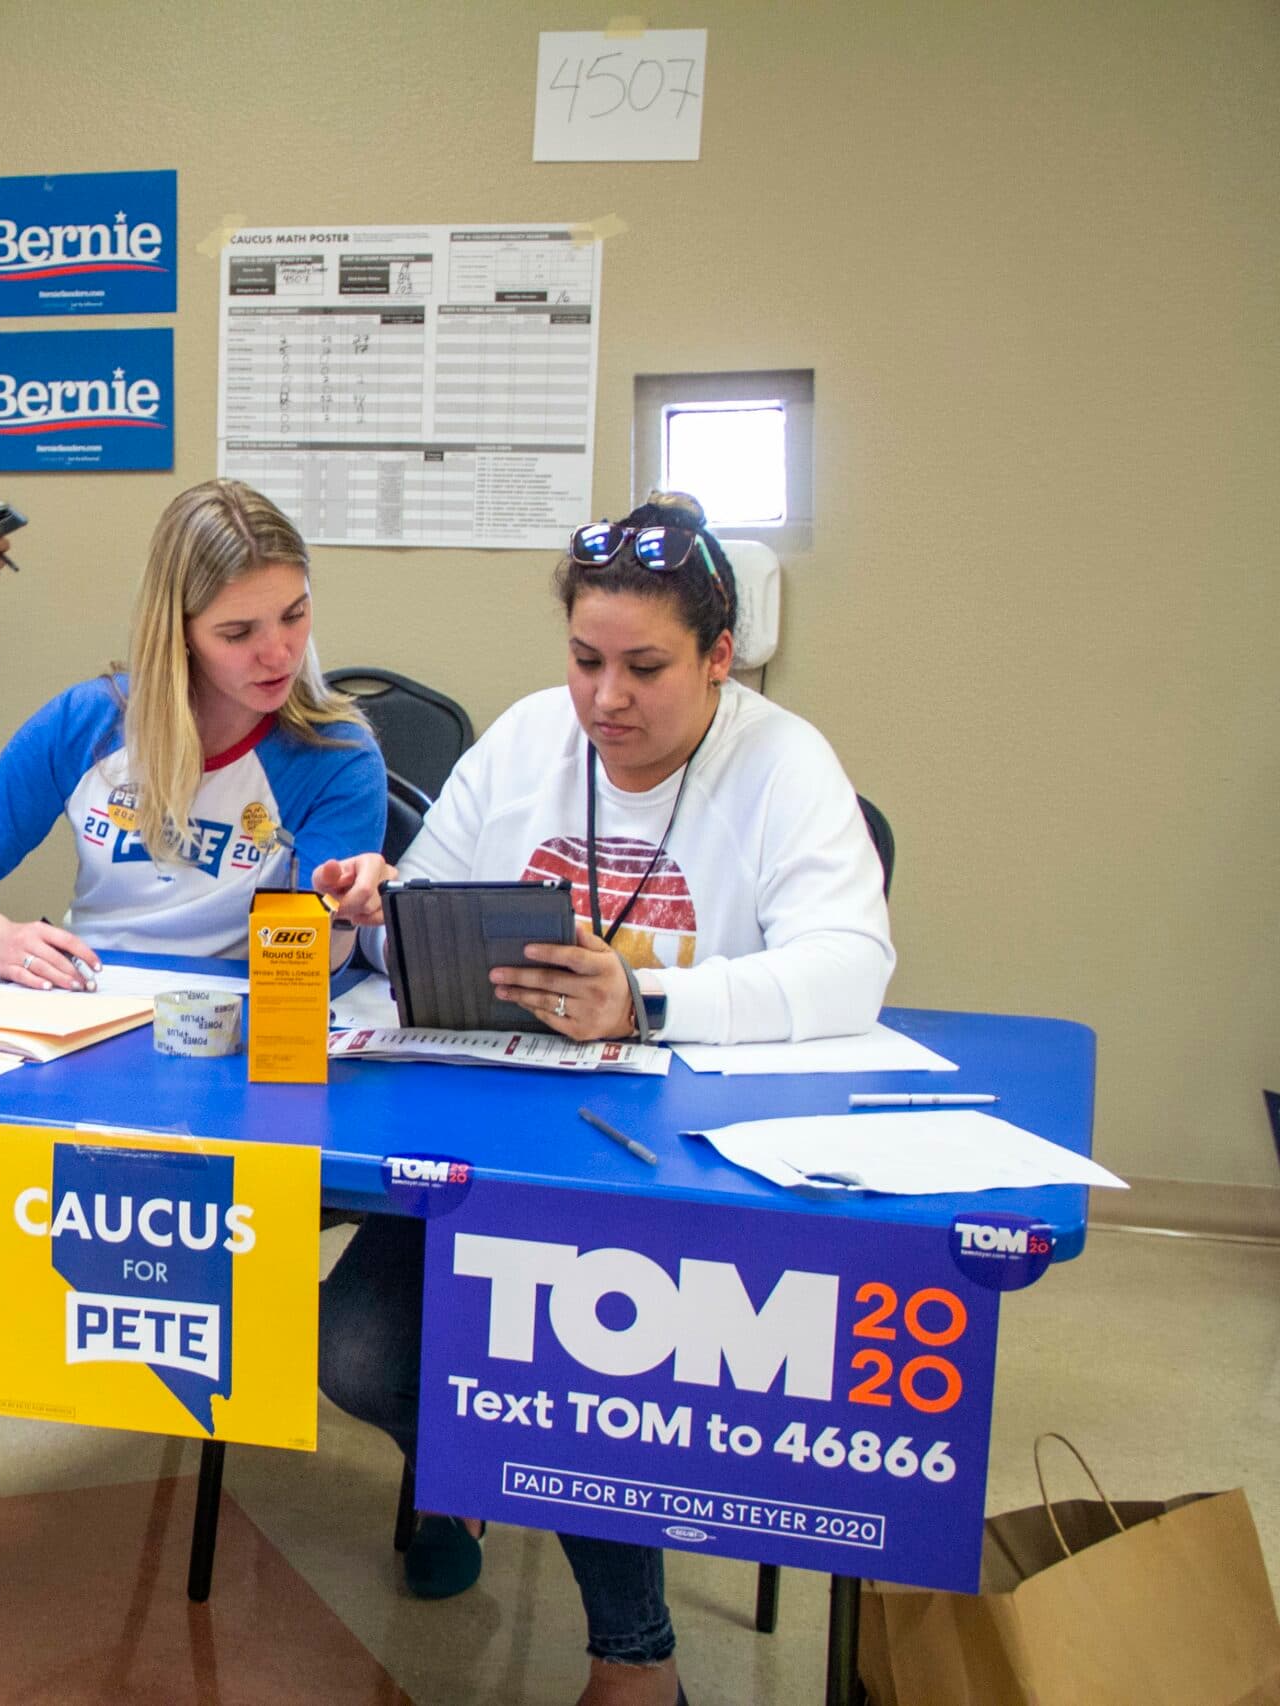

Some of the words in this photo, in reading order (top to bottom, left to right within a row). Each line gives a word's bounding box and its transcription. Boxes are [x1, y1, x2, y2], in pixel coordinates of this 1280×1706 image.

[549, 51, 700, 123] 4507
[230, 233, 273, 245] CAUCUS
[276, 232, 307, 244] MATH
[309, 231, 350, 243] POSTER
[83, 815, 110, 839] 20
[231, 842, 261, 863] 20
[262, 949, 294, 960] Round
[274, 931, 313, 944] BIC
[386, 1156, 451, 1183] TOM
[13, 1186, 257, 1255] CAUCUS
[954, 1222, 1028, 1254] TOM
[122, 1258, 169, 1283] FOR
[76, 1302, 209, 1362] PETE
[452, 1231, 840, 1402] TOM
[851, 1281, 968, 1348] 20
[847, 1348, 964, 1414] 20
[447, 1375, 554, 1430] Text
[567, 1391, 692, 1448] TOM
[706, 1413, 763, 1457] to
[772, 1420, 957, 1483] 46866
[514, 1471, 564, 1497] PAID
[571, 1480, 616, 1504] FOR
[623, 1488, 653, 1509] BY
[660, 1492, 714, 1518] TOM
[721, 1502, 807, 1531] STEYER
[814, 1515, 877, 1542] 2020
